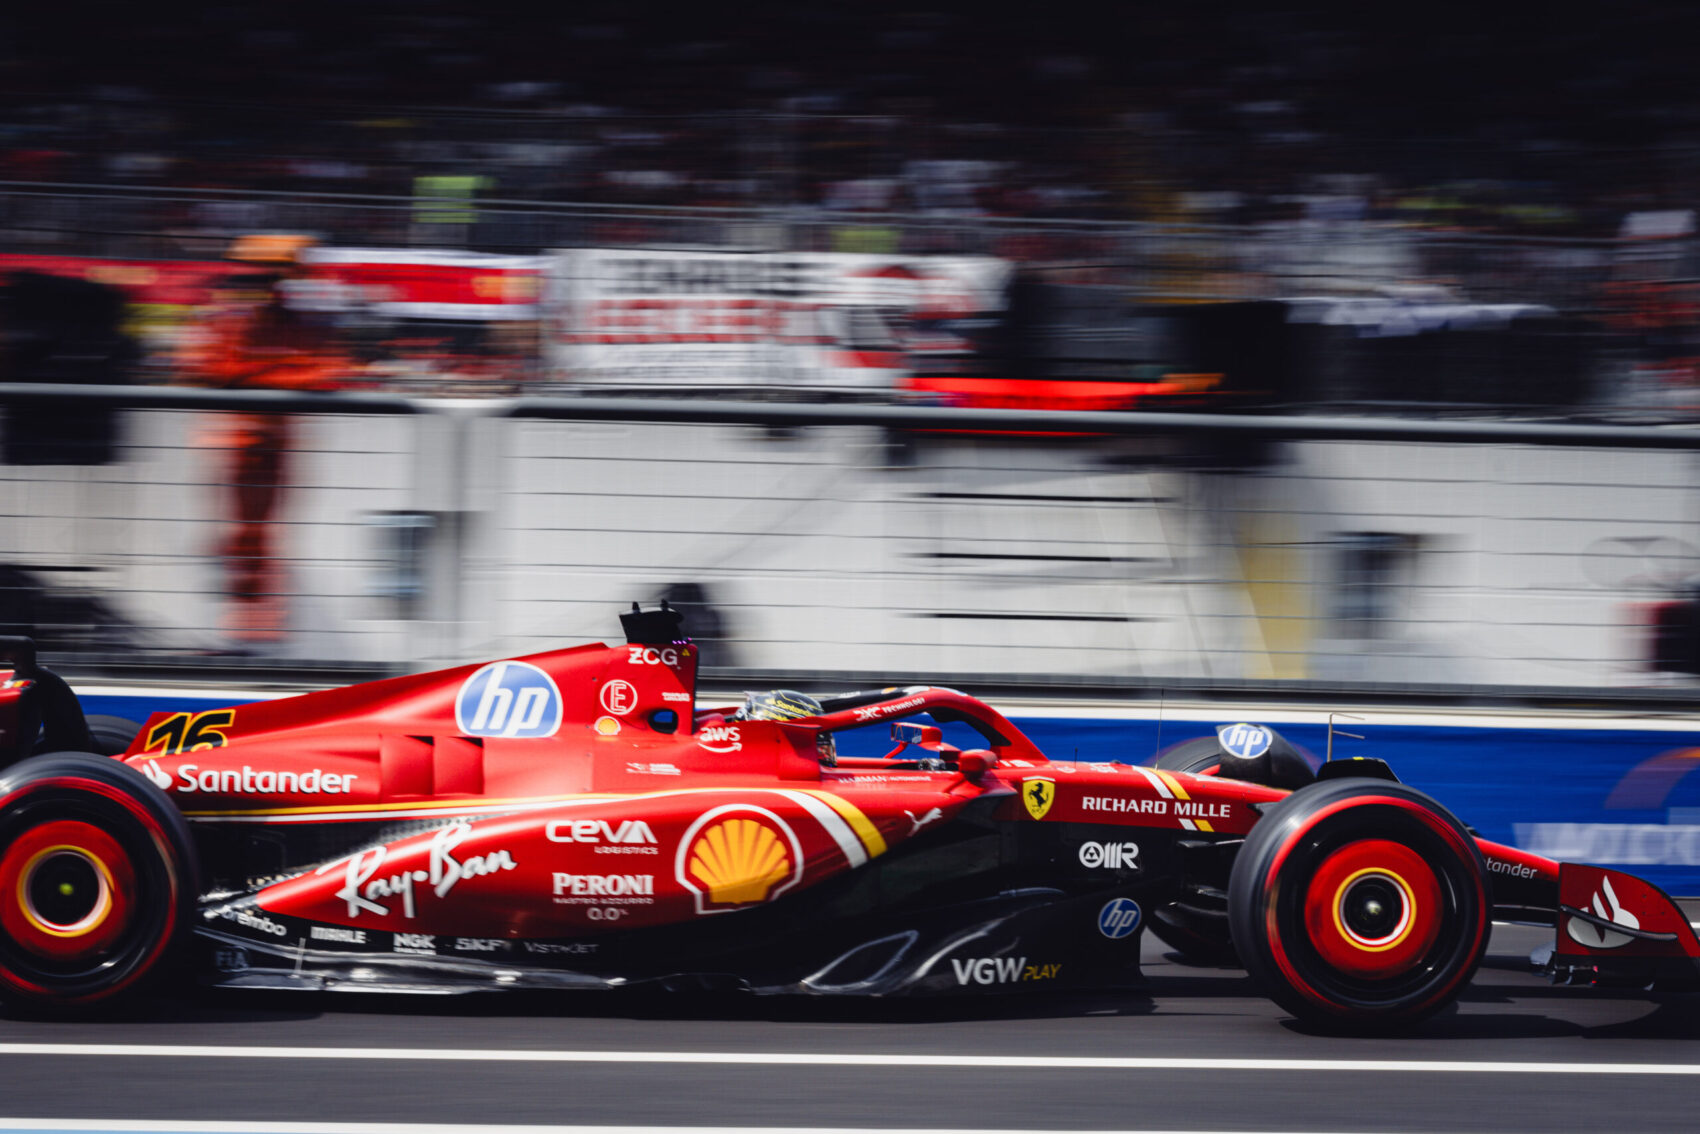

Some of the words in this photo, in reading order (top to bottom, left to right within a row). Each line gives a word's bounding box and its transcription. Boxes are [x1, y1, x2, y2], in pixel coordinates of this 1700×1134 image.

[470, 662, 550, 737] hp
[141, 709, 236, 759] 16
[700, 726, 741, 741] aws
[1228, 725, 1265, 758] hp
[177, 764, 358, 793] Santander
[1082, 796, 1167, 815] RICHARD
[1174, 802, 1231, 818] MILLE
[594, 846, 658, 855] LOGISTICS
[1483, 857, 1538, 879] tander
[552, 872, 654, 895] PERONI
[1103, 899, 1137, 938] hp
[393, 932, 437, 949] NGK
[454, 937, 503, 951] SKF
[951, 957, 1027, 985] VGW
[1023, 963, 1062, 981] PLAY
